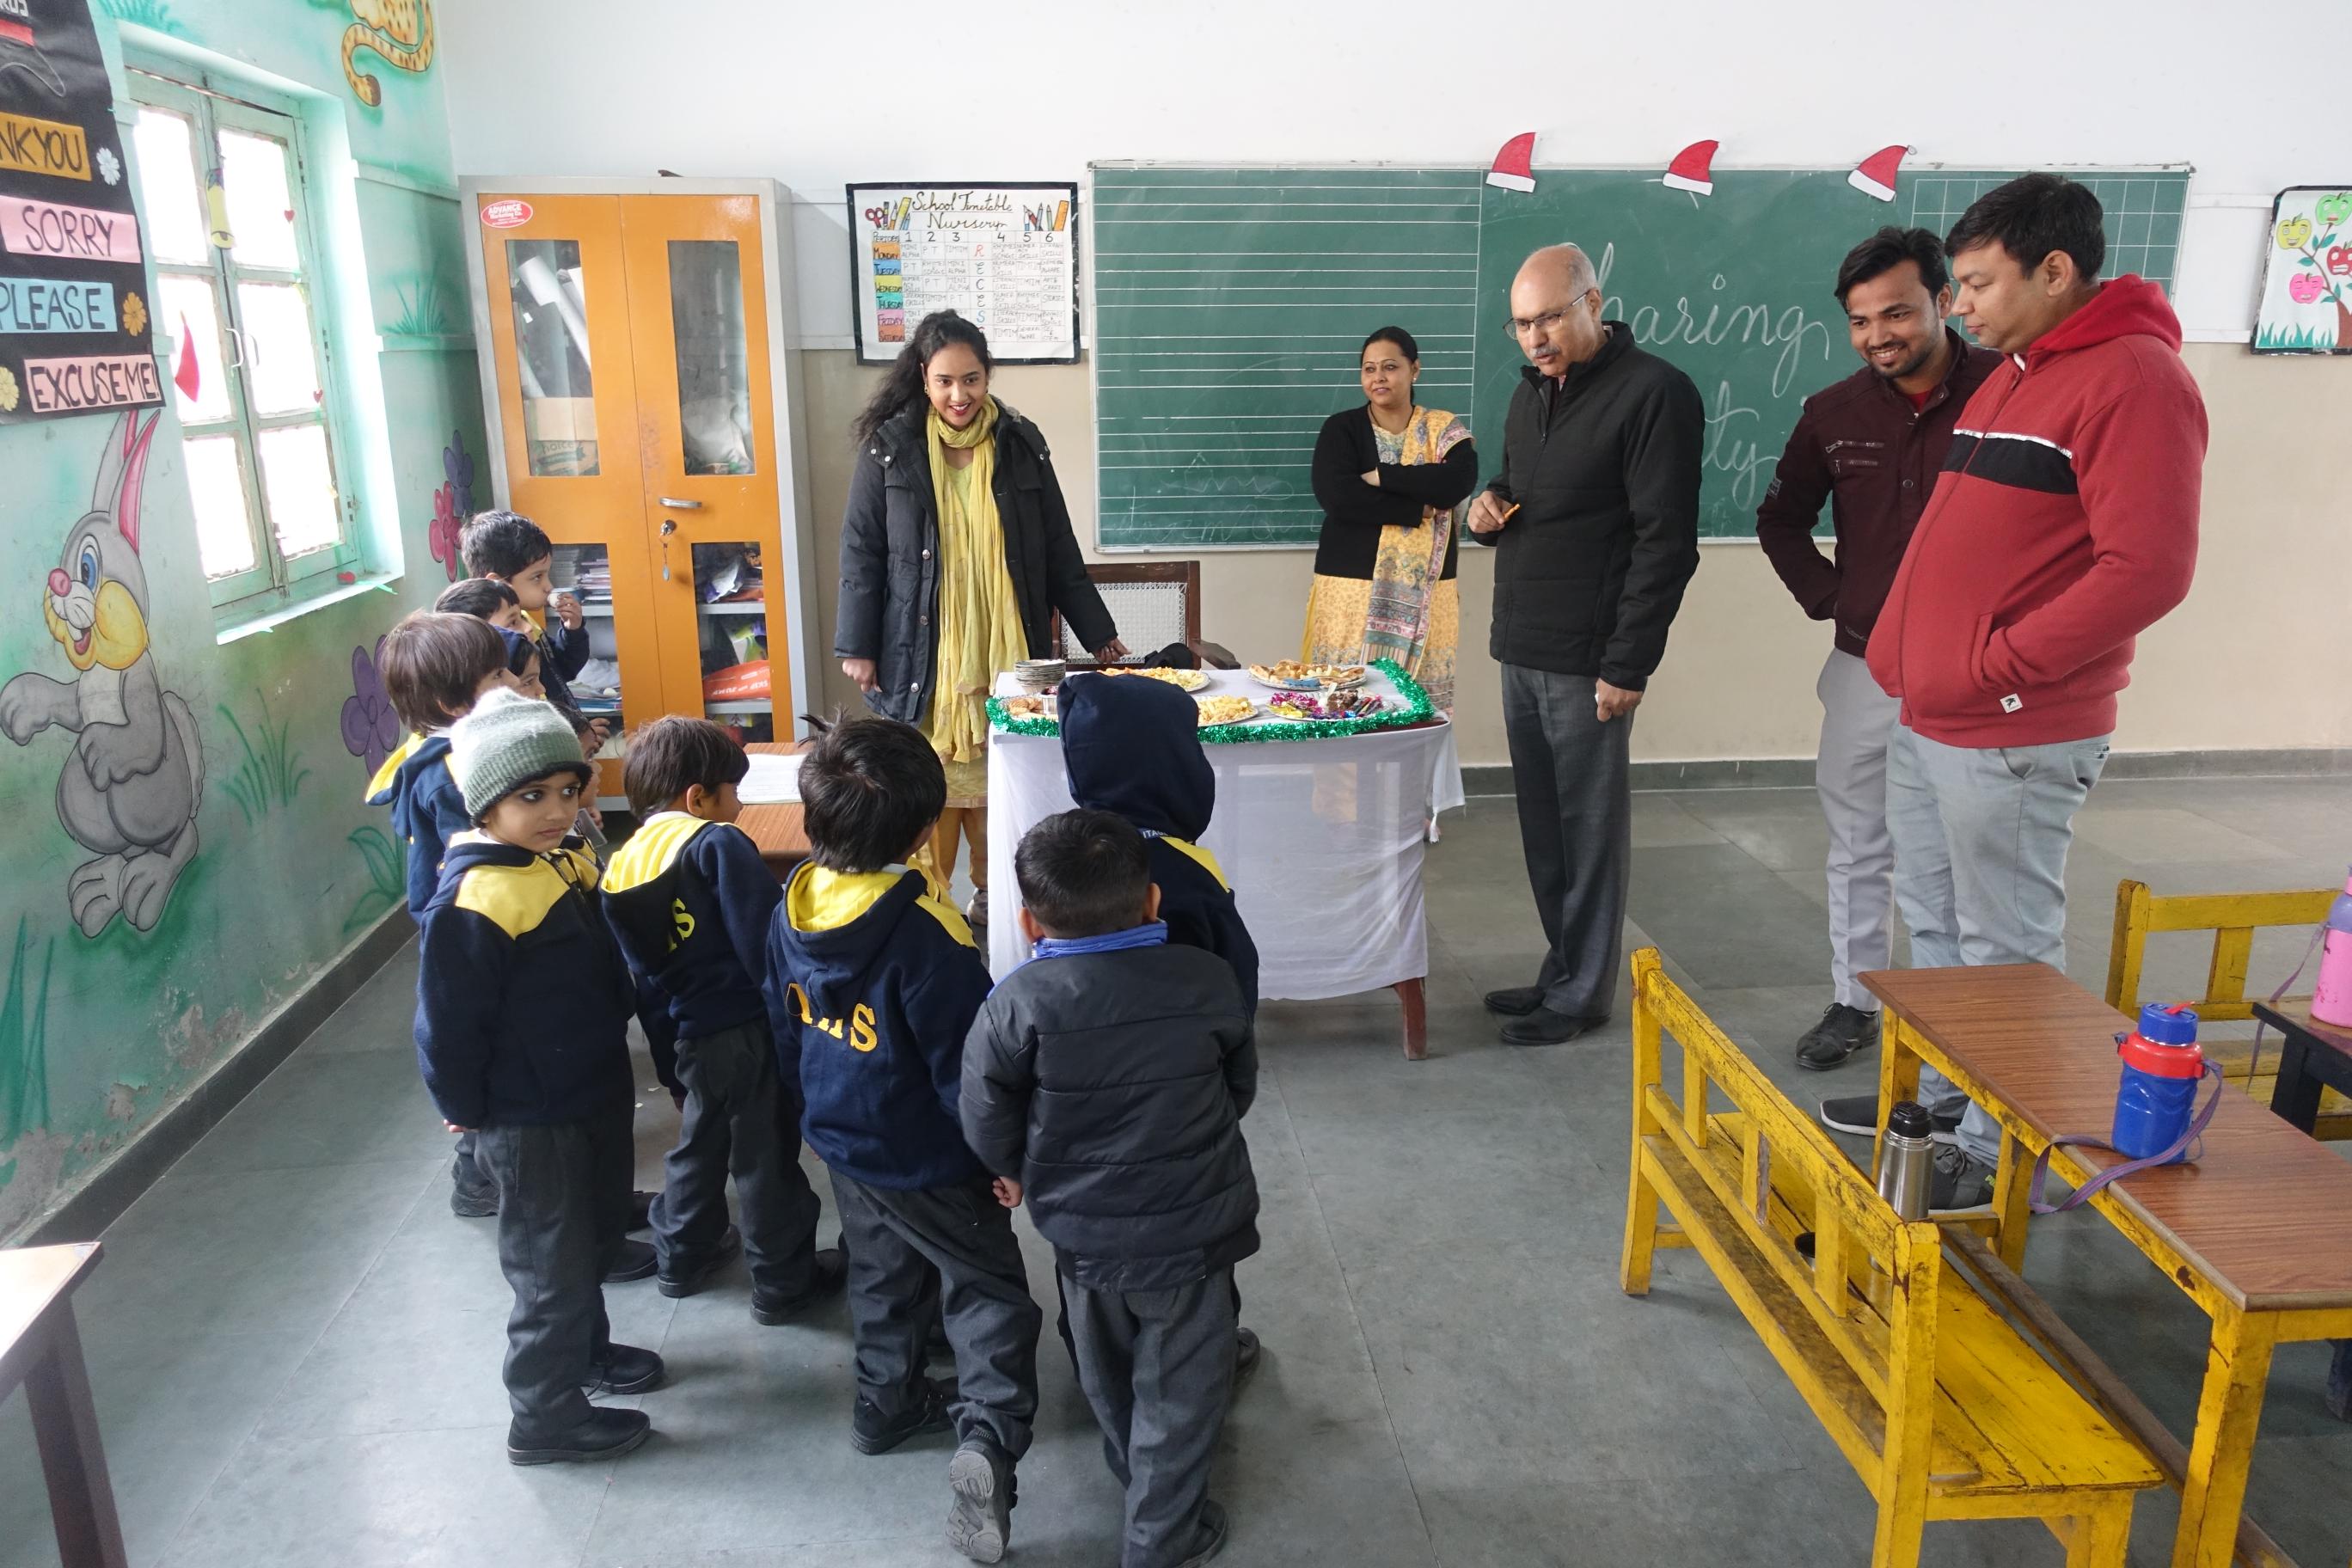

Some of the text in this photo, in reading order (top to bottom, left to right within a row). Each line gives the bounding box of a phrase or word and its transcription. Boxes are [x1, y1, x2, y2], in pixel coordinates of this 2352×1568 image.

[912, 191, 1013, 211] School Timetable
[21, 205, 115, 257] SORRY
[927, 211, 1008, 231] Nursery
[905, 232, 912, 242] 1
[927, 231, 935, 242] 2
[952, 231, 960, 242] 3
[997, 232, 1005, 242] 4
[1023, 233, 1032, 242] 5
[1045, 232, 1053, 242] 6
[873, 247, 899, 260] MONDAY
[0, 282, 105, 330] PLEASE
[878, 314, 903, 326] FRIDAY
